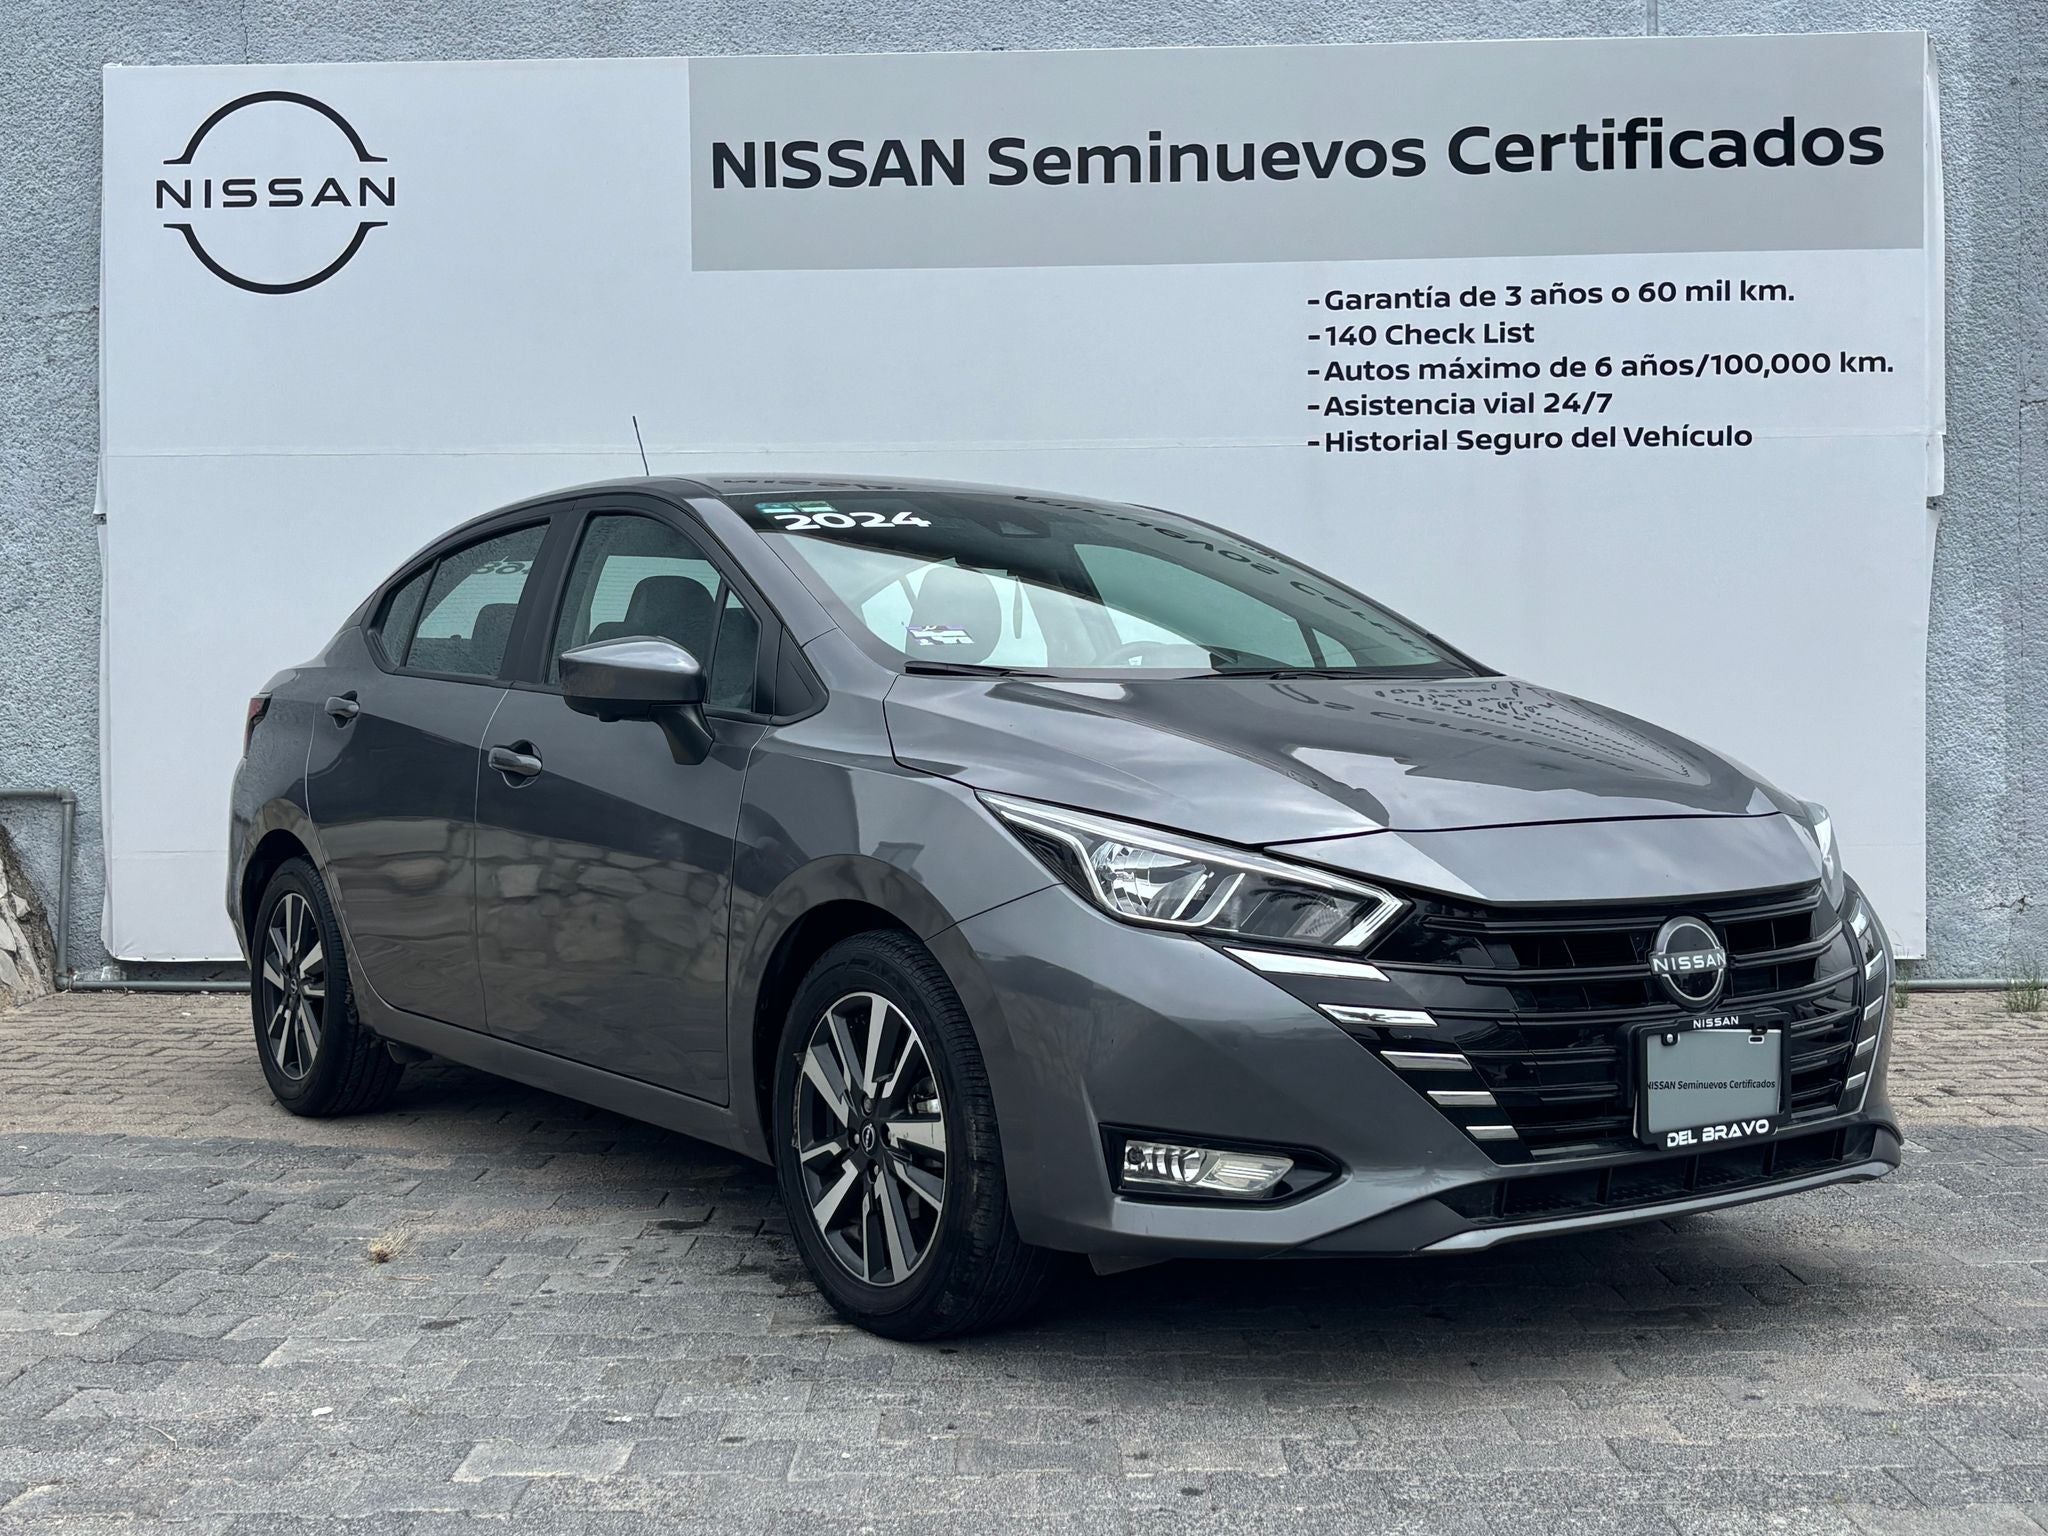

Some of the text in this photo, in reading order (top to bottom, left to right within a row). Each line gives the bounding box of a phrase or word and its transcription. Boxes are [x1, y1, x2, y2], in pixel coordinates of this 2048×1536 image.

[711, 116, 1885, 190] NISSAN Seminuevos Certificados
[156, 176, 396, 209] NISSAN
[1458, 285, 1497, 308] de
[1505, 285, 1522, 307] 3
[1528, 282, 1604, 306] años
[1611, 286, 1630, 304] o
[1638, 281, 1677, 303] 60
[1685, 279, 1731, 302] mil
[1740, 279, 1795, 301] km.
[1385, 322, 1476, 346] Check
[1484, 321, 1535, 344] List
[1418, 356, 1541, 380] máximo
[1549, 356, 1587, 378] de
[1594, 356, 1613, 378] 6
[1621, 352, 1831, 379] años/100,000
[1840, 351, 1894, 373] km.
[1483, 392, 1535, 414] vial
[1543, 390, 1613, 415] 24/7
[1456, 429, 1563, 456] Seguro
[1571, 425, 1616, 448] del
[1622, 423, 1753, 448] Vehículo
[774, 511, 932, 531] 2024
[1652, 952, 1727, 972] NISSAN
[1692, 1015, 1739, 1029] NISSAN
[1677, 1080, 1728, 1090] Seminuevos
[1729, 1079, 1776, 1089] Certificados
[1666, 1118, 1770, 1148] DEL BRAVO
